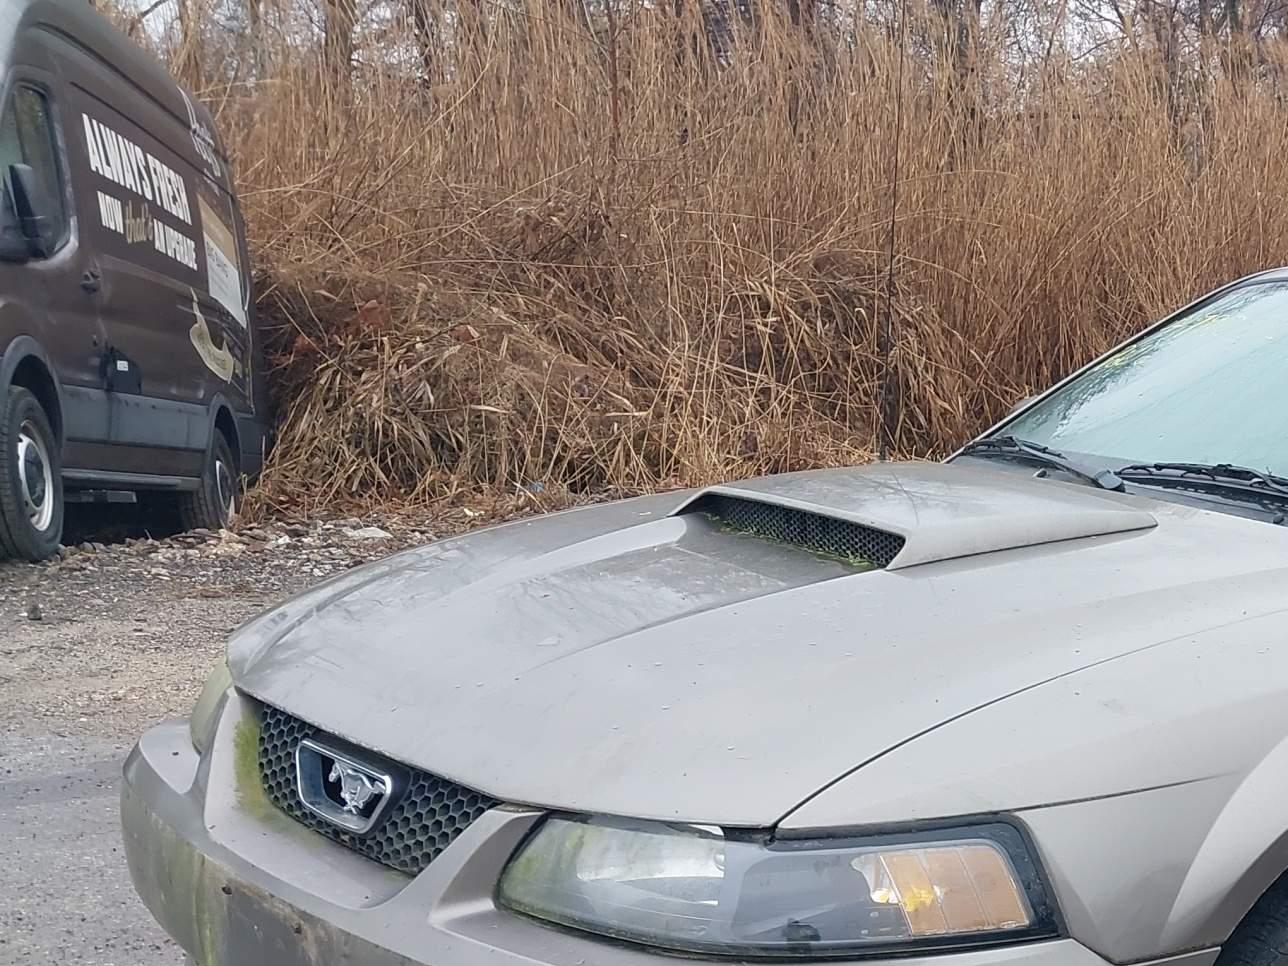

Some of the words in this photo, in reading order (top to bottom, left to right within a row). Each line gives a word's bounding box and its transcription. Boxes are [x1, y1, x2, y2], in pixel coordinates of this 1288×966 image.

[82, 113, 153, 201] ALWAYS
[146, 153, 192, 225] FRESH
[97, 191, 124, 234] NOW
